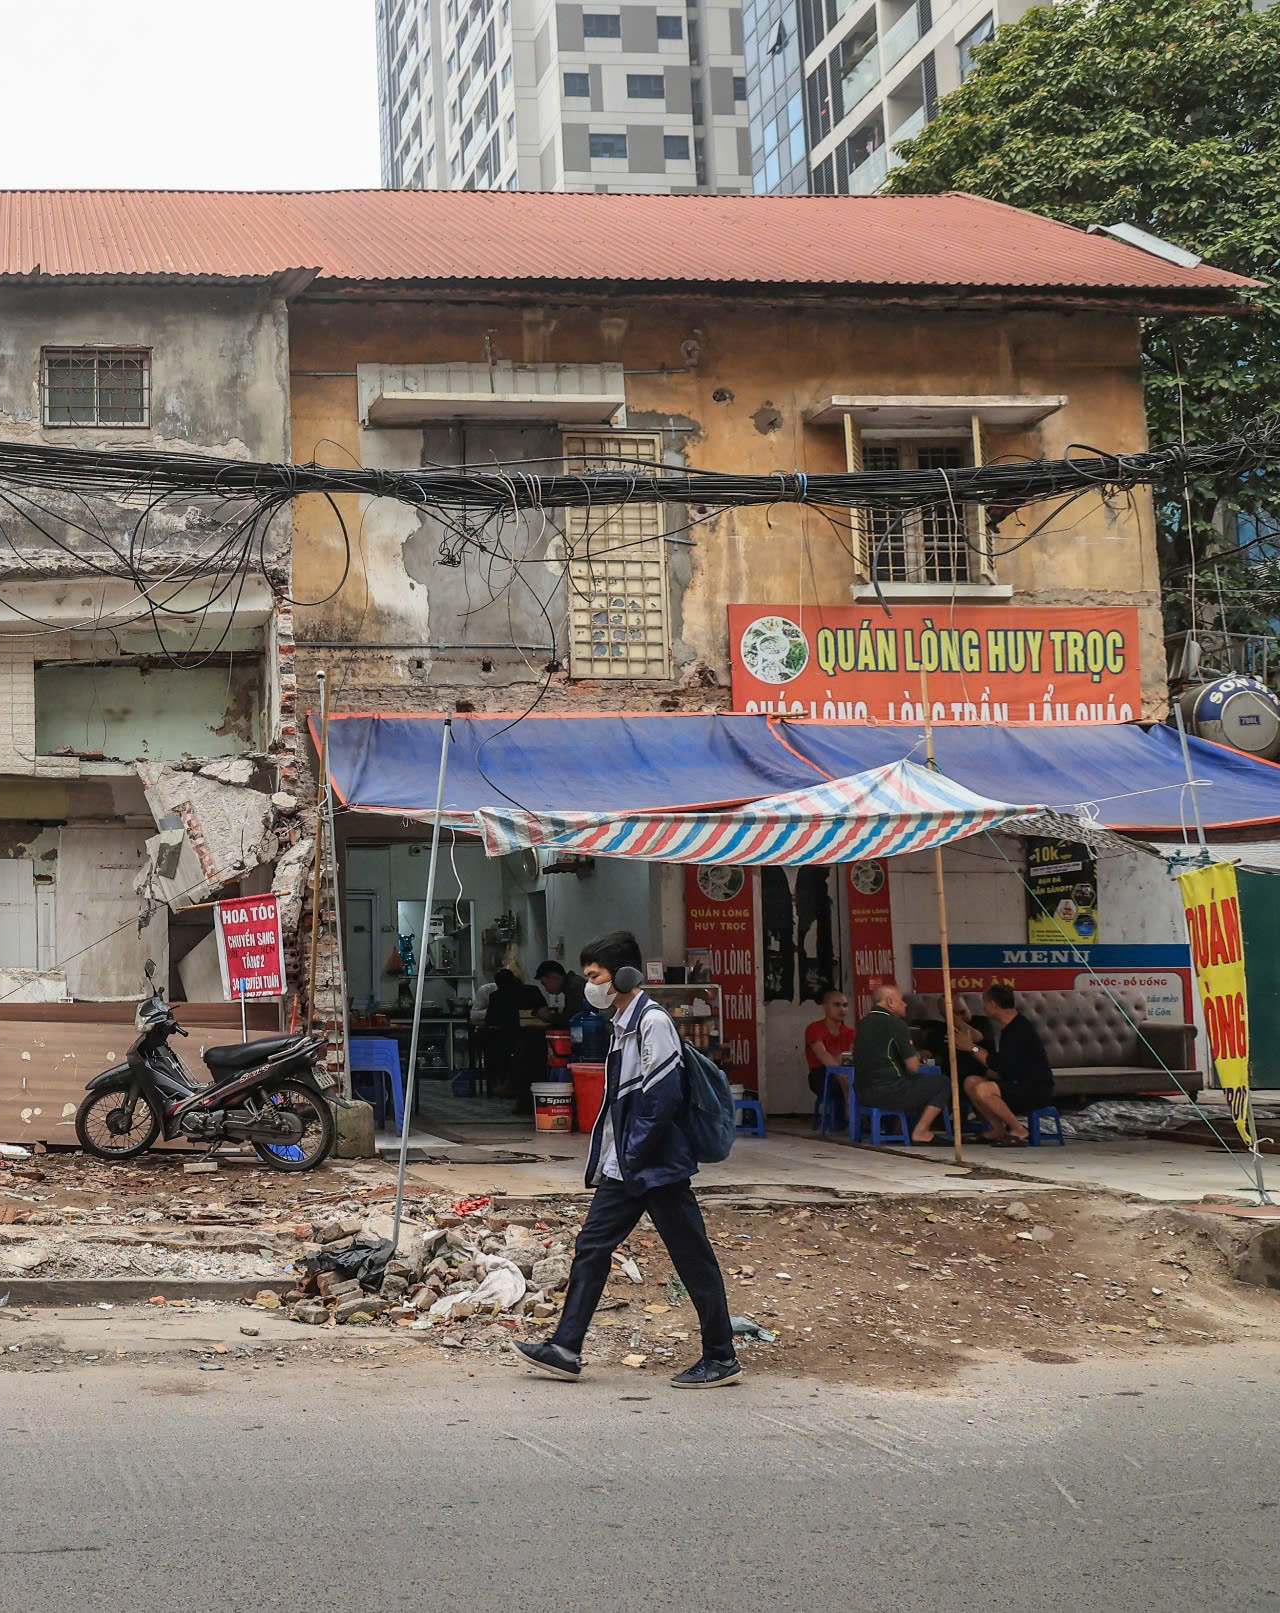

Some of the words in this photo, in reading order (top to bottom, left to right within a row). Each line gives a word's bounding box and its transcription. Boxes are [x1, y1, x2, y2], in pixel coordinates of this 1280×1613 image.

[817, 619, 898, 676] QUÁN
[905, 618, 980, 674] LÒNG
[987, 629, 1043, 674] HUY
[1049, 629, 1125, 683] TRỌC
[221, 908, 249, 925] HOA
[250, 903, 276, 922] TÓC
[694, 922, 716, 931] HUY
[256, 930, 276, 946] SANG
[723, 943, 752, 976] LÒNG
[1002, 950, 1091, 964] MENU
[1203, 981, 1247, 1061] ÒNG
